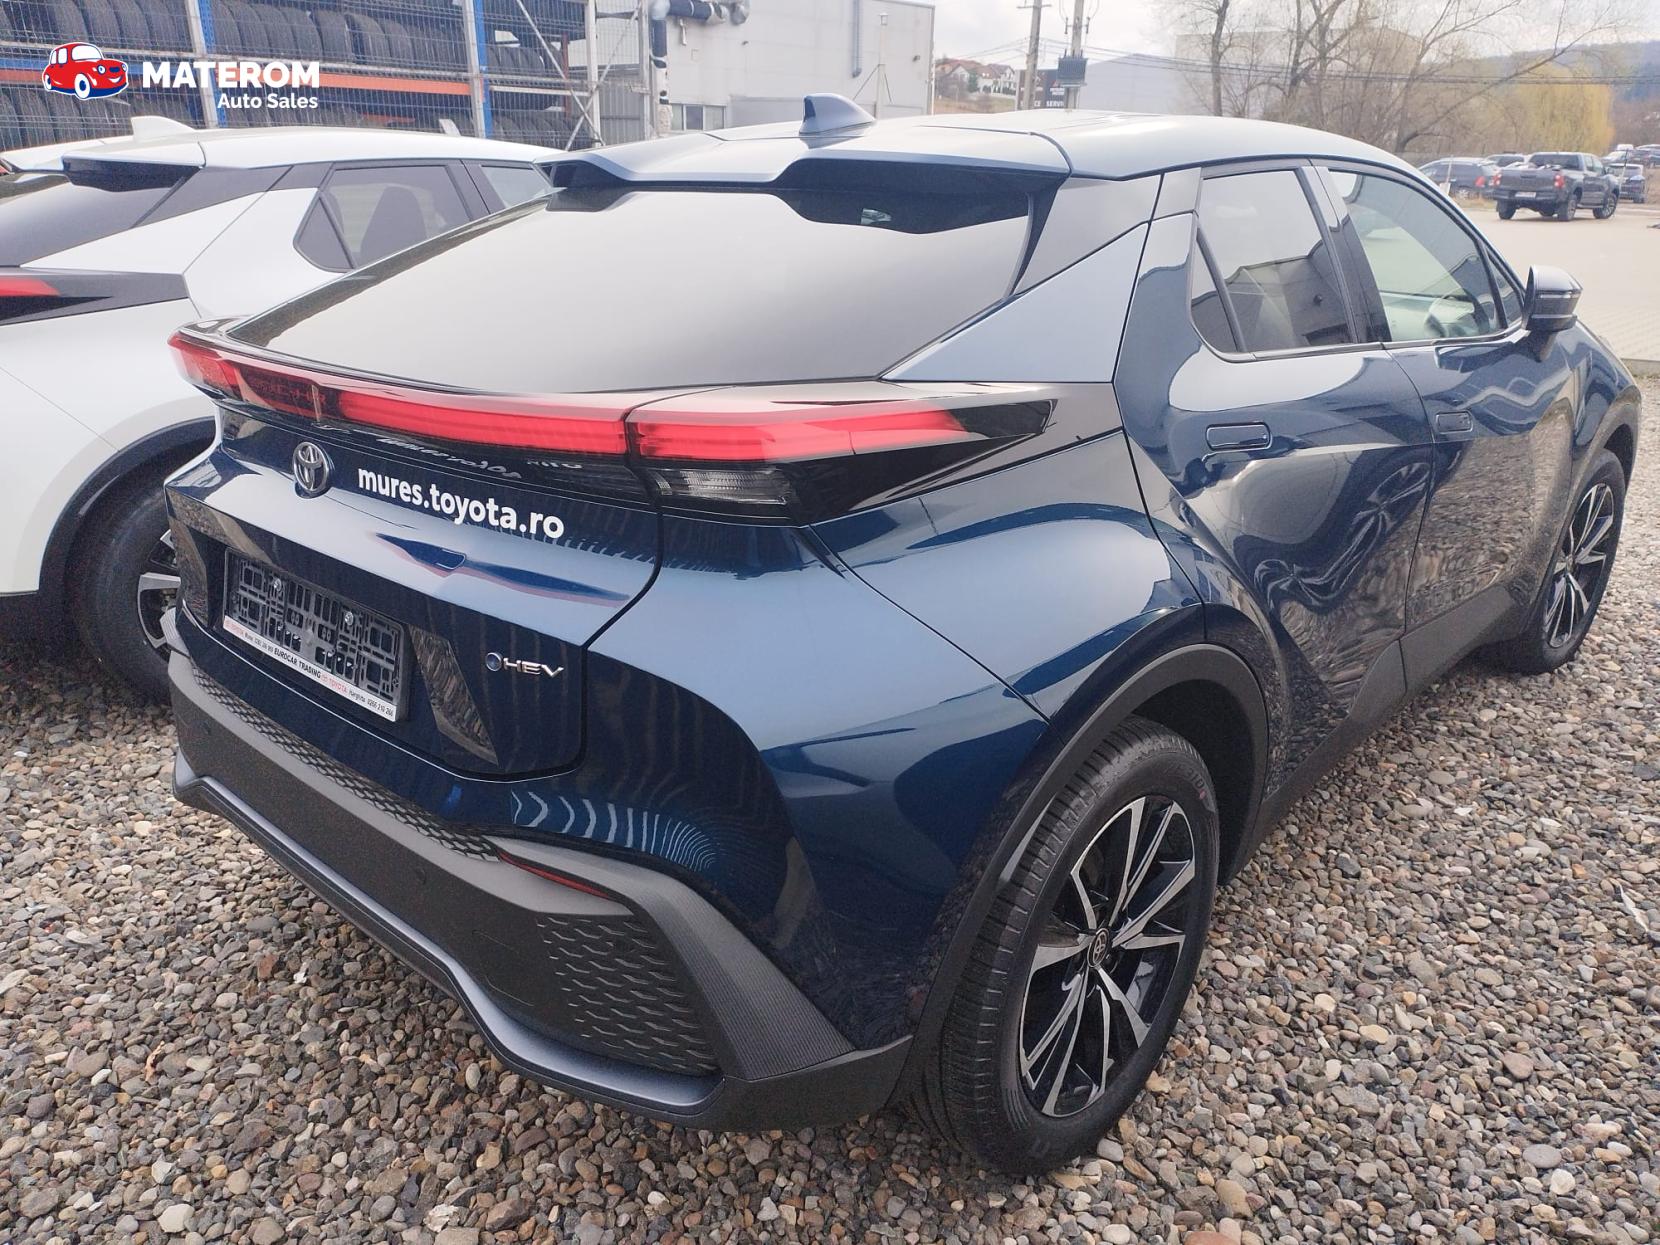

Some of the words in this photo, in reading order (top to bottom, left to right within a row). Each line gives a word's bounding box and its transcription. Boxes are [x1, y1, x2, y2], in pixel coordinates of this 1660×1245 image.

[358, 468, 565, 539] mures.toyota.ro
[274, 647, 298, 665] EUROCAR
[299, 661, 322, 679] TRADING
[503, 657, 564, 678] HEV
